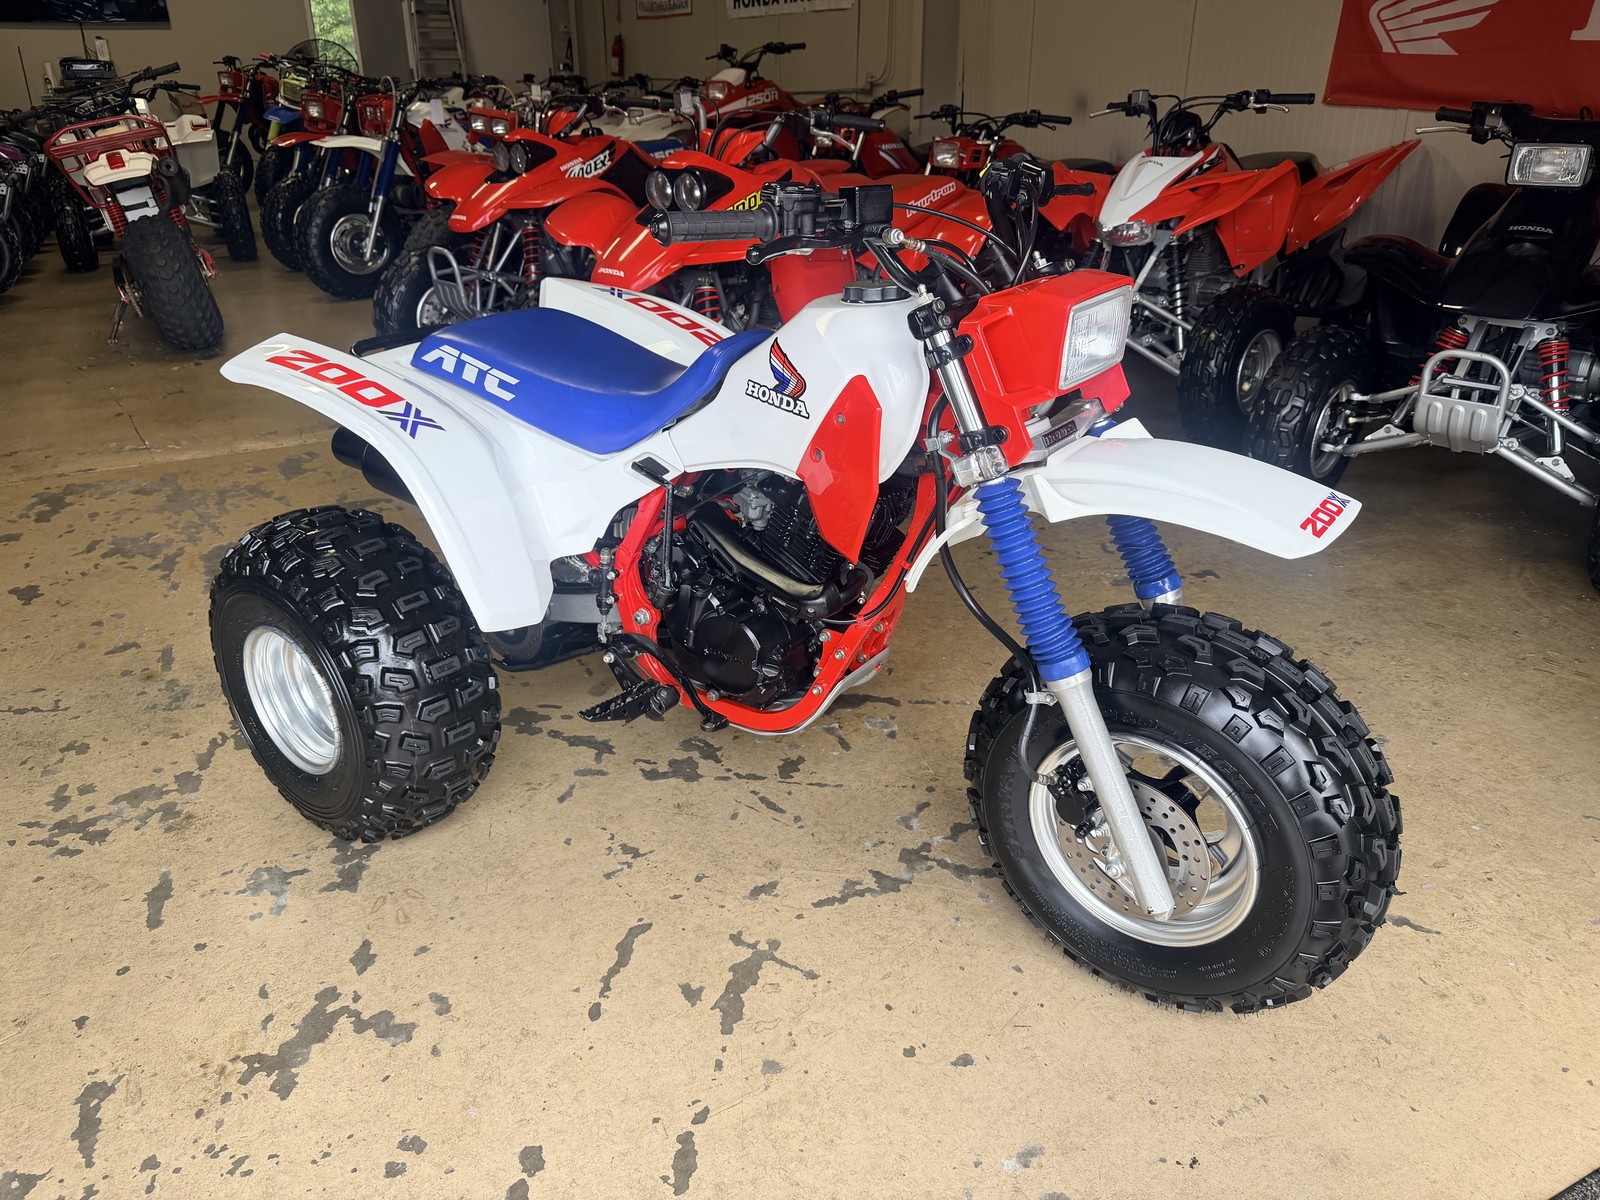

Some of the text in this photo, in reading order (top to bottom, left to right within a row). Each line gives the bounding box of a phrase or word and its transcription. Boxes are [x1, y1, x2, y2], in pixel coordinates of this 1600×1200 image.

[747, 90, 779, 107] 250R
[560, 156, 584, 172] HONDA
[1508, 225, 1554, 235] HONDA
[421, 344, 520, 402] ATC
[265, 349, 447, 440] 200X
[745, 379, 810, 420] HONDA
[1299, 491, 1352, 539] 200X
